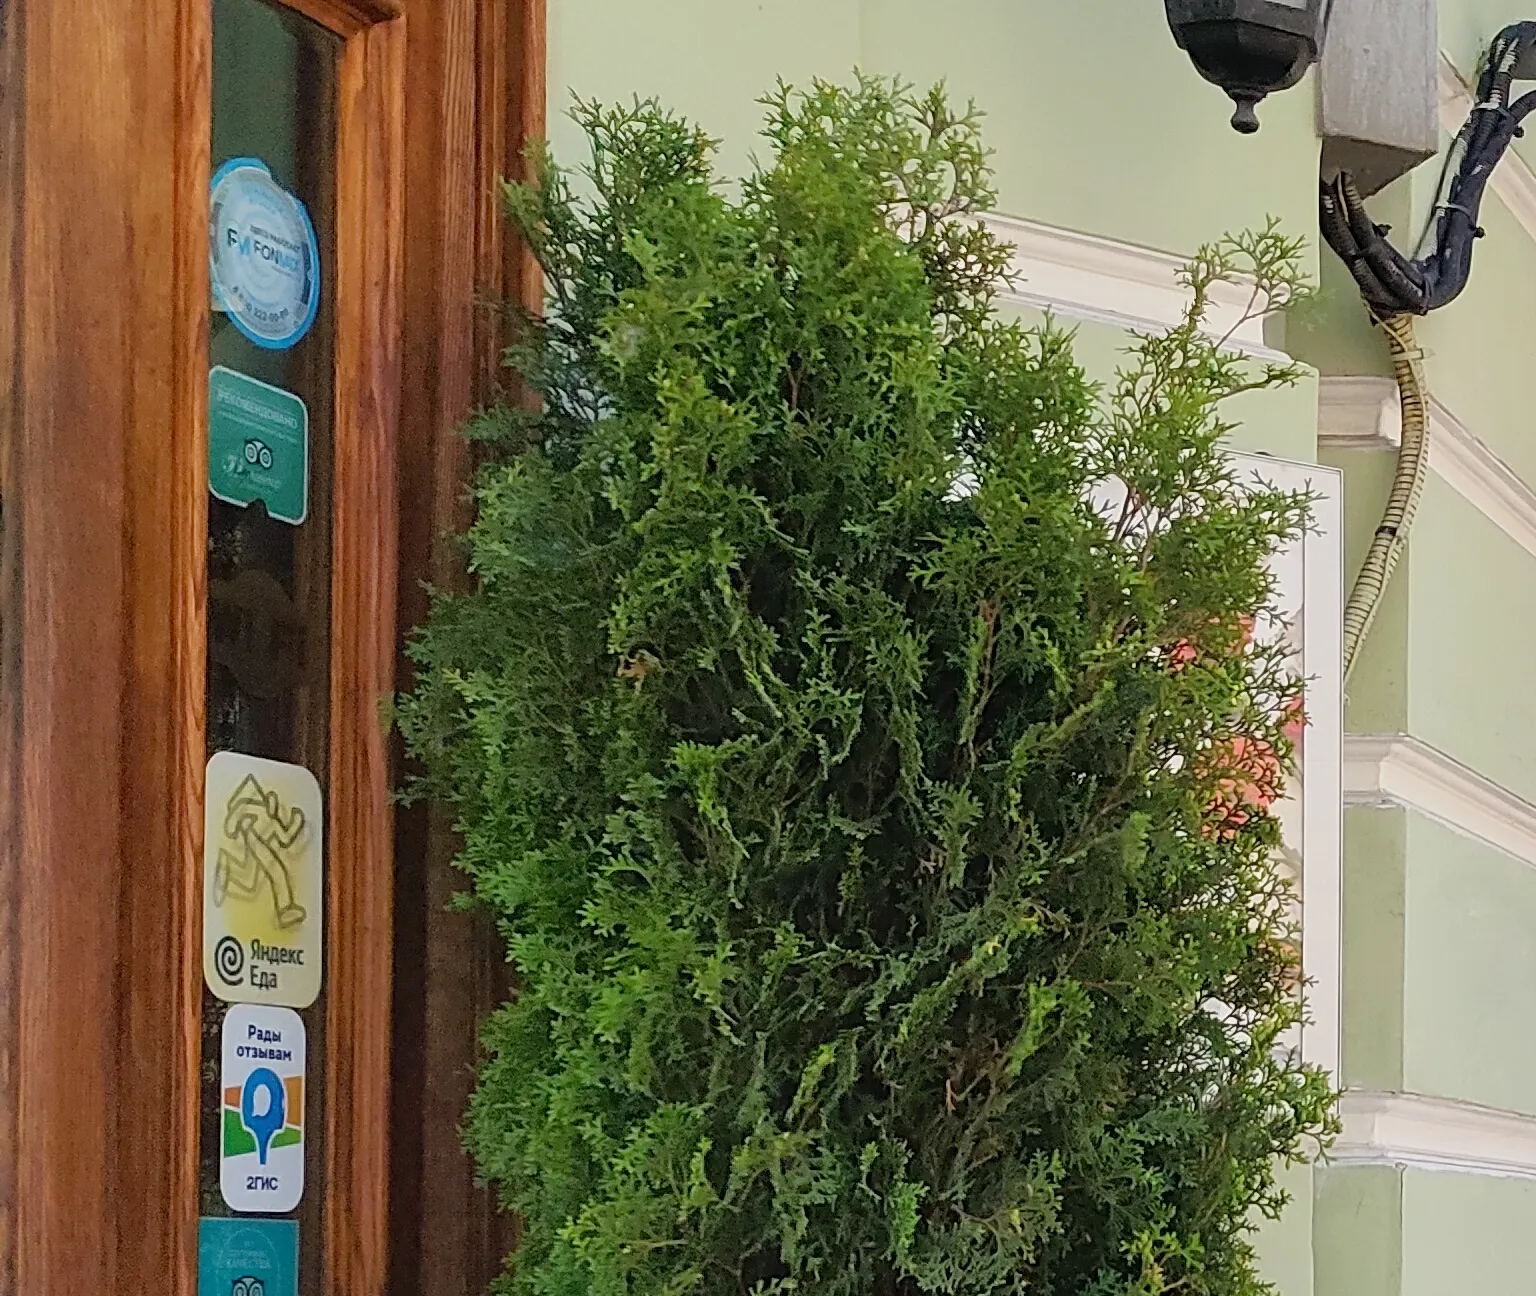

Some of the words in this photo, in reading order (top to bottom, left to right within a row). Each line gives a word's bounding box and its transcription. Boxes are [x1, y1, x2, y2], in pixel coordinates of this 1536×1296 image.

[251, 938, 304, 965] Яндекс
[250, 964, 277, 989] Еда
[248, 1024, 281, 1042] Рады
[236, 1045, 292, 1061] отзывам
[246, 1175, 279, 1191] 2ГИС
